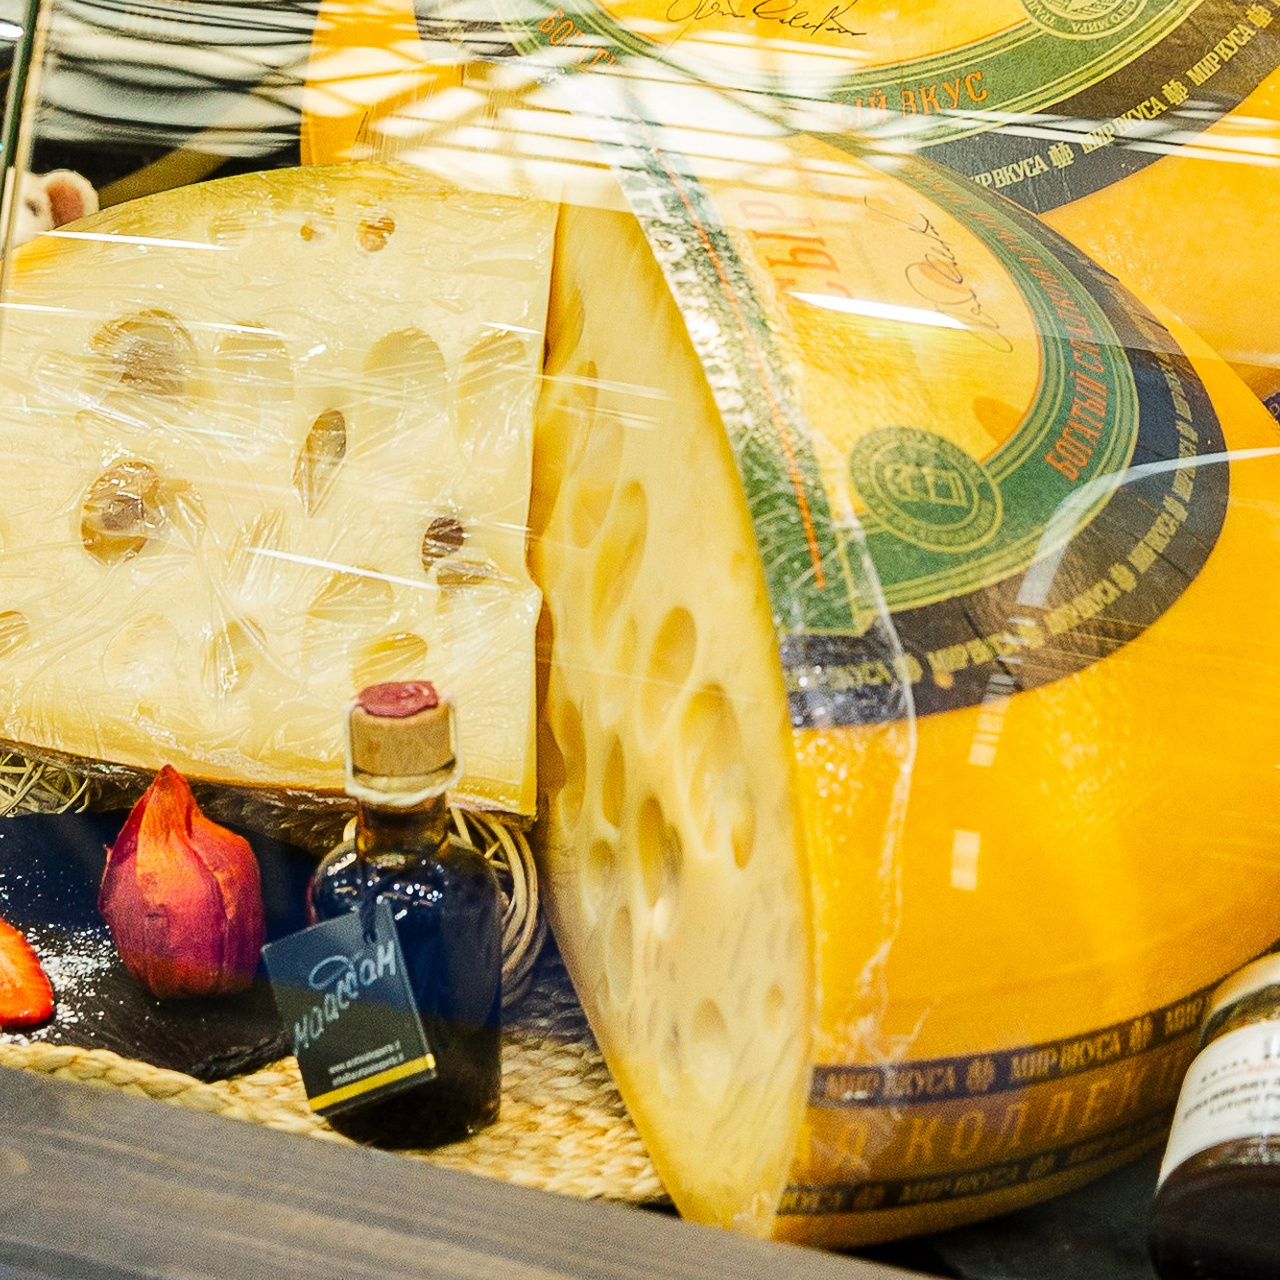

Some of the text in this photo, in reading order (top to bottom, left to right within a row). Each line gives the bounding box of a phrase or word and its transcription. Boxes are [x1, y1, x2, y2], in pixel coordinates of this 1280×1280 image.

[901, 71, 988, 118] ВКУС
[994, 154, 1050, 190] ВКУСА
[1081, 123, 1116, 155] МИР
[1113, 96, 1169, 139] ВКУСА
[1186, 52, 1222, 87] МИР
[1214, 21, 1257, 63] ВКУСА
[1045, 370, 1109, 482] БОГАТЫЙ
